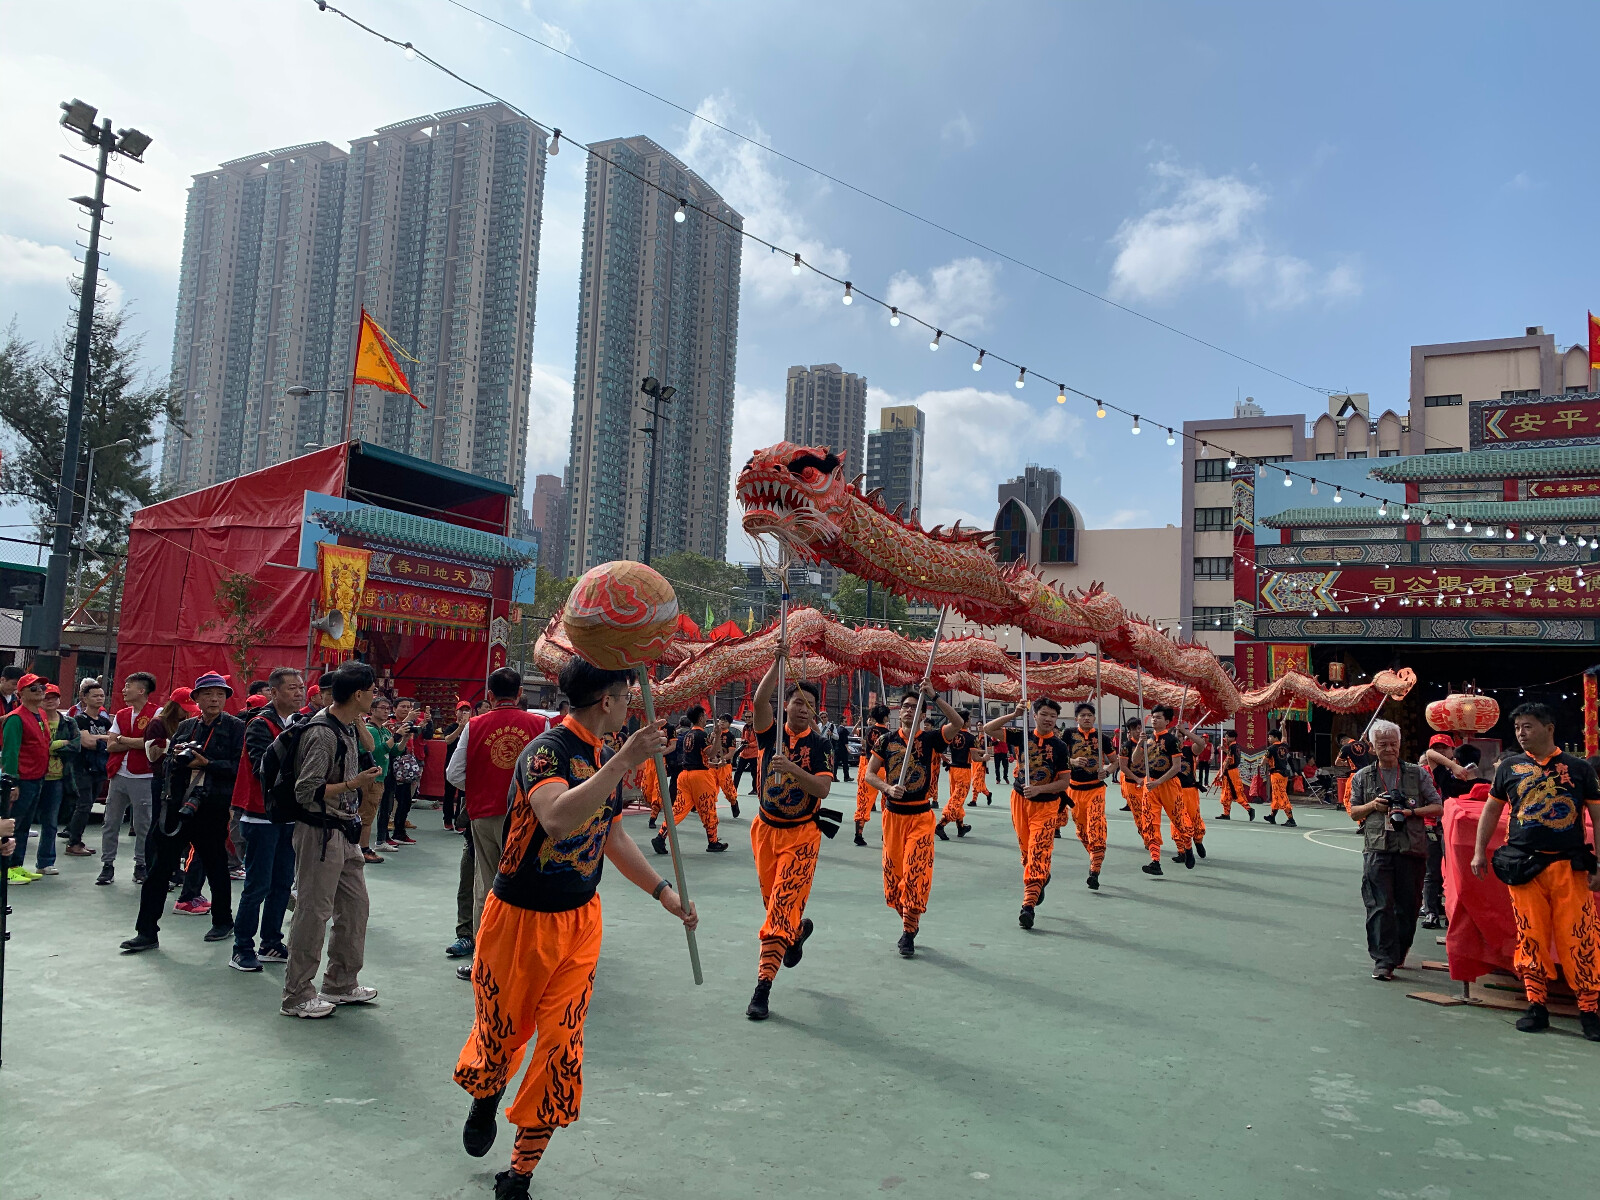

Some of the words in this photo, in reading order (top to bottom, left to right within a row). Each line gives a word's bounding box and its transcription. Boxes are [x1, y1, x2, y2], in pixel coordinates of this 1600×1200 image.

[1509, 409, 1600, 433] 平安
[395, 560, 467, 584] 天地同春
